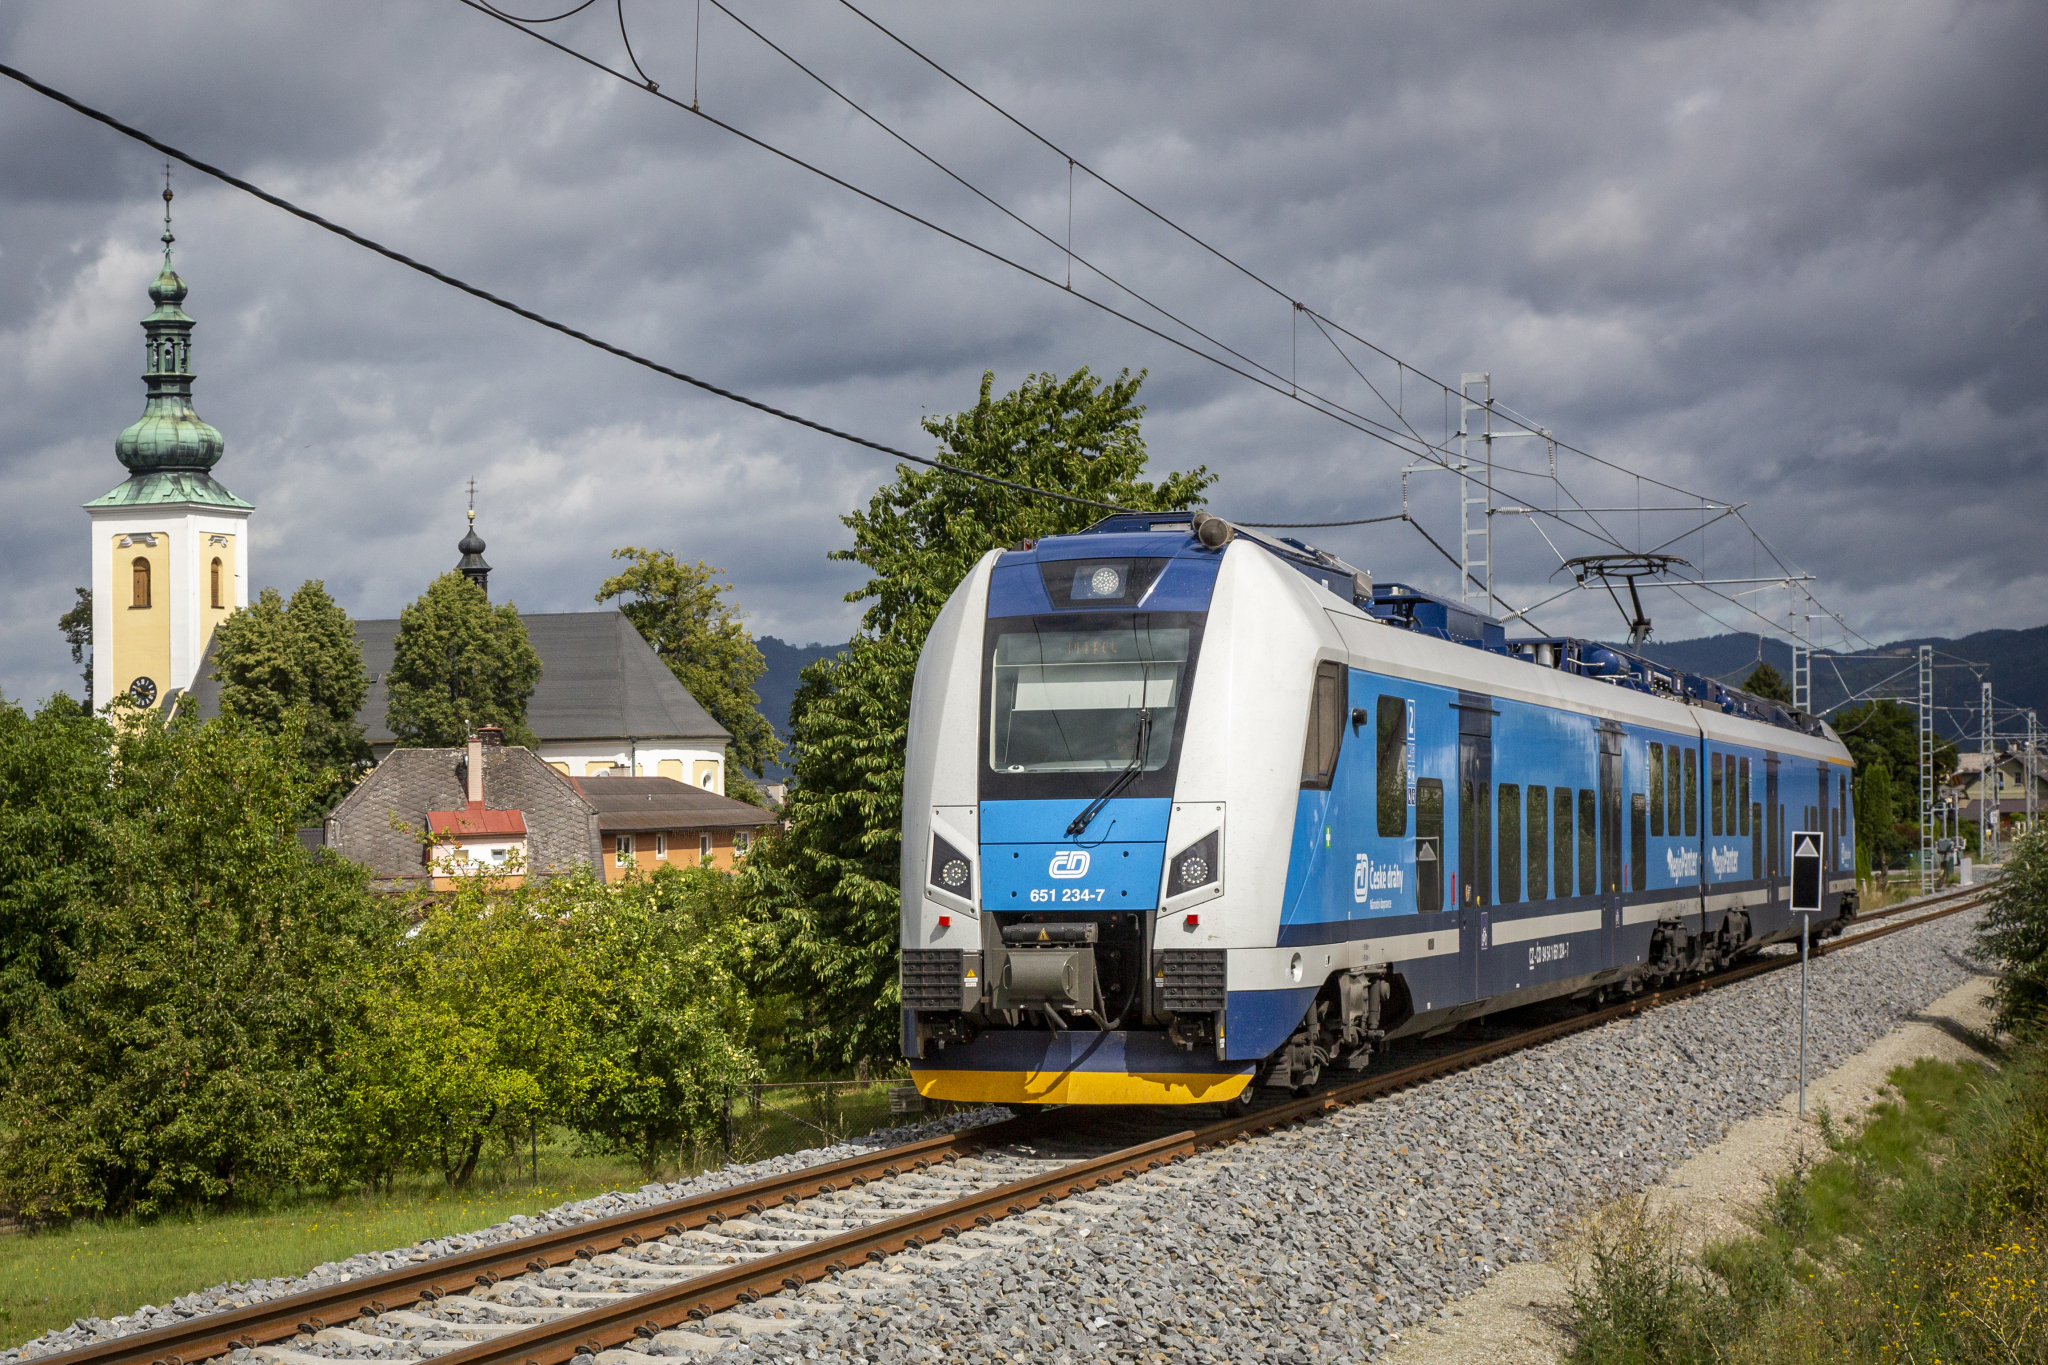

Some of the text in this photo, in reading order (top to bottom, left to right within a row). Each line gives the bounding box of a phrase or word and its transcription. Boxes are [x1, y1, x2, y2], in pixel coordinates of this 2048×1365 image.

[1409, 706, 1414, 734] 2
[1370, 860, 1404, 894] České dráhy
[1030, 888, 1106, 902] 651 234-7
